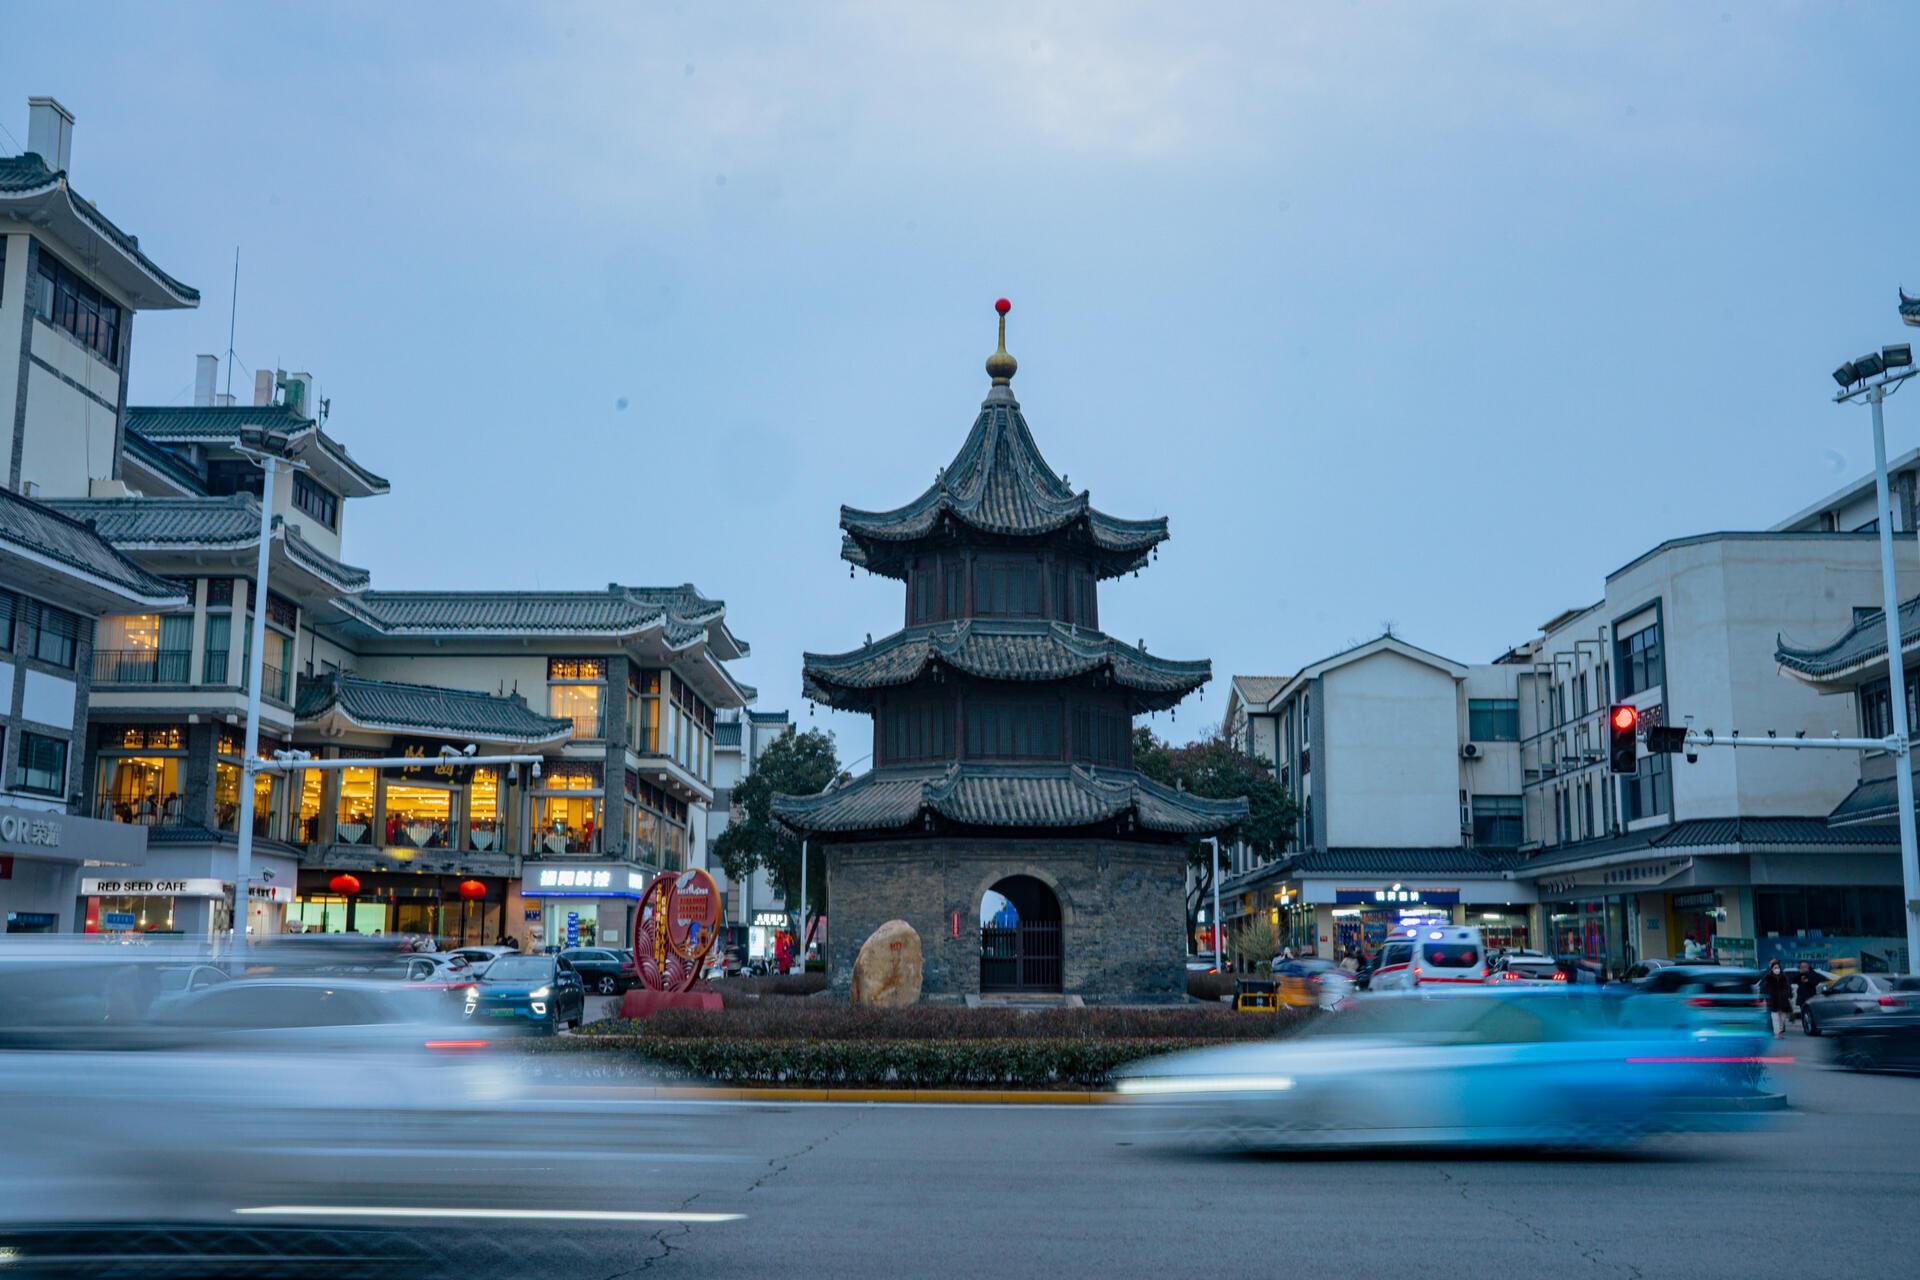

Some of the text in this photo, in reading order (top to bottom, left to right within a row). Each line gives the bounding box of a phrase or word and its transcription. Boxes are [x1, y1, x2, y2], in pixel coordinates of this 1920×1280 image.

[97, 881, 187, 892] RED SEED CAFE
